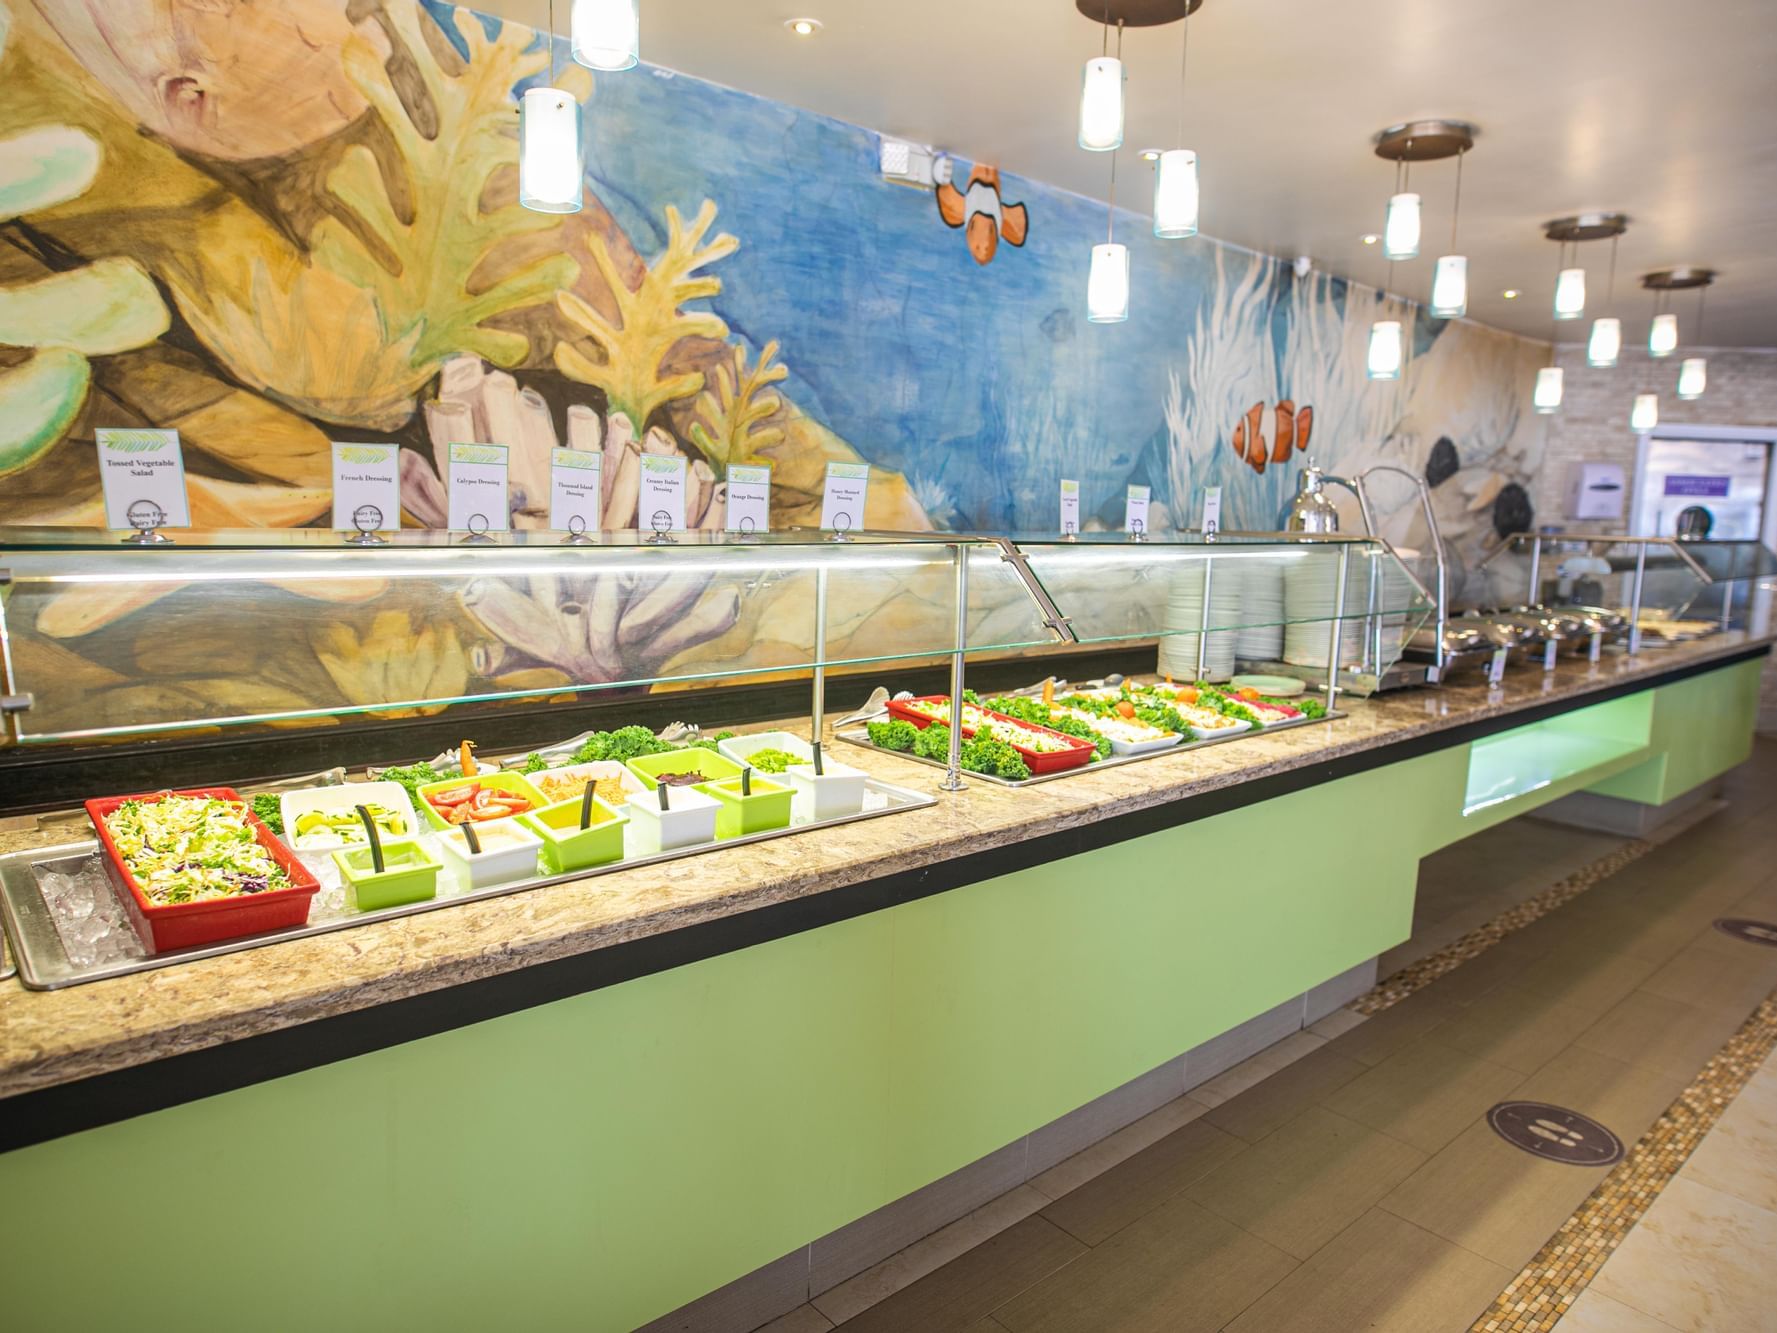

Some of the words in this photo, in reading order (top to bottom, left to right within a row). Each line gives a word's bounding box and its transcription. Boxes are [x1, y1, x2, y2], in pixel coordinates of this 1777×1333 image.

[106, 459, 134, 467] Tossed
[136, 459, 175, 468] Vegetable
[130, 469, 154, 477] Salad
[365, 474, 393, 483] Dressing
[478, 478, 500, 486] Dressing
[580, 482, 593, 490] Island
[566, 490, 585, 498] Dressing
[747, 494, 765, 502] Dressing
